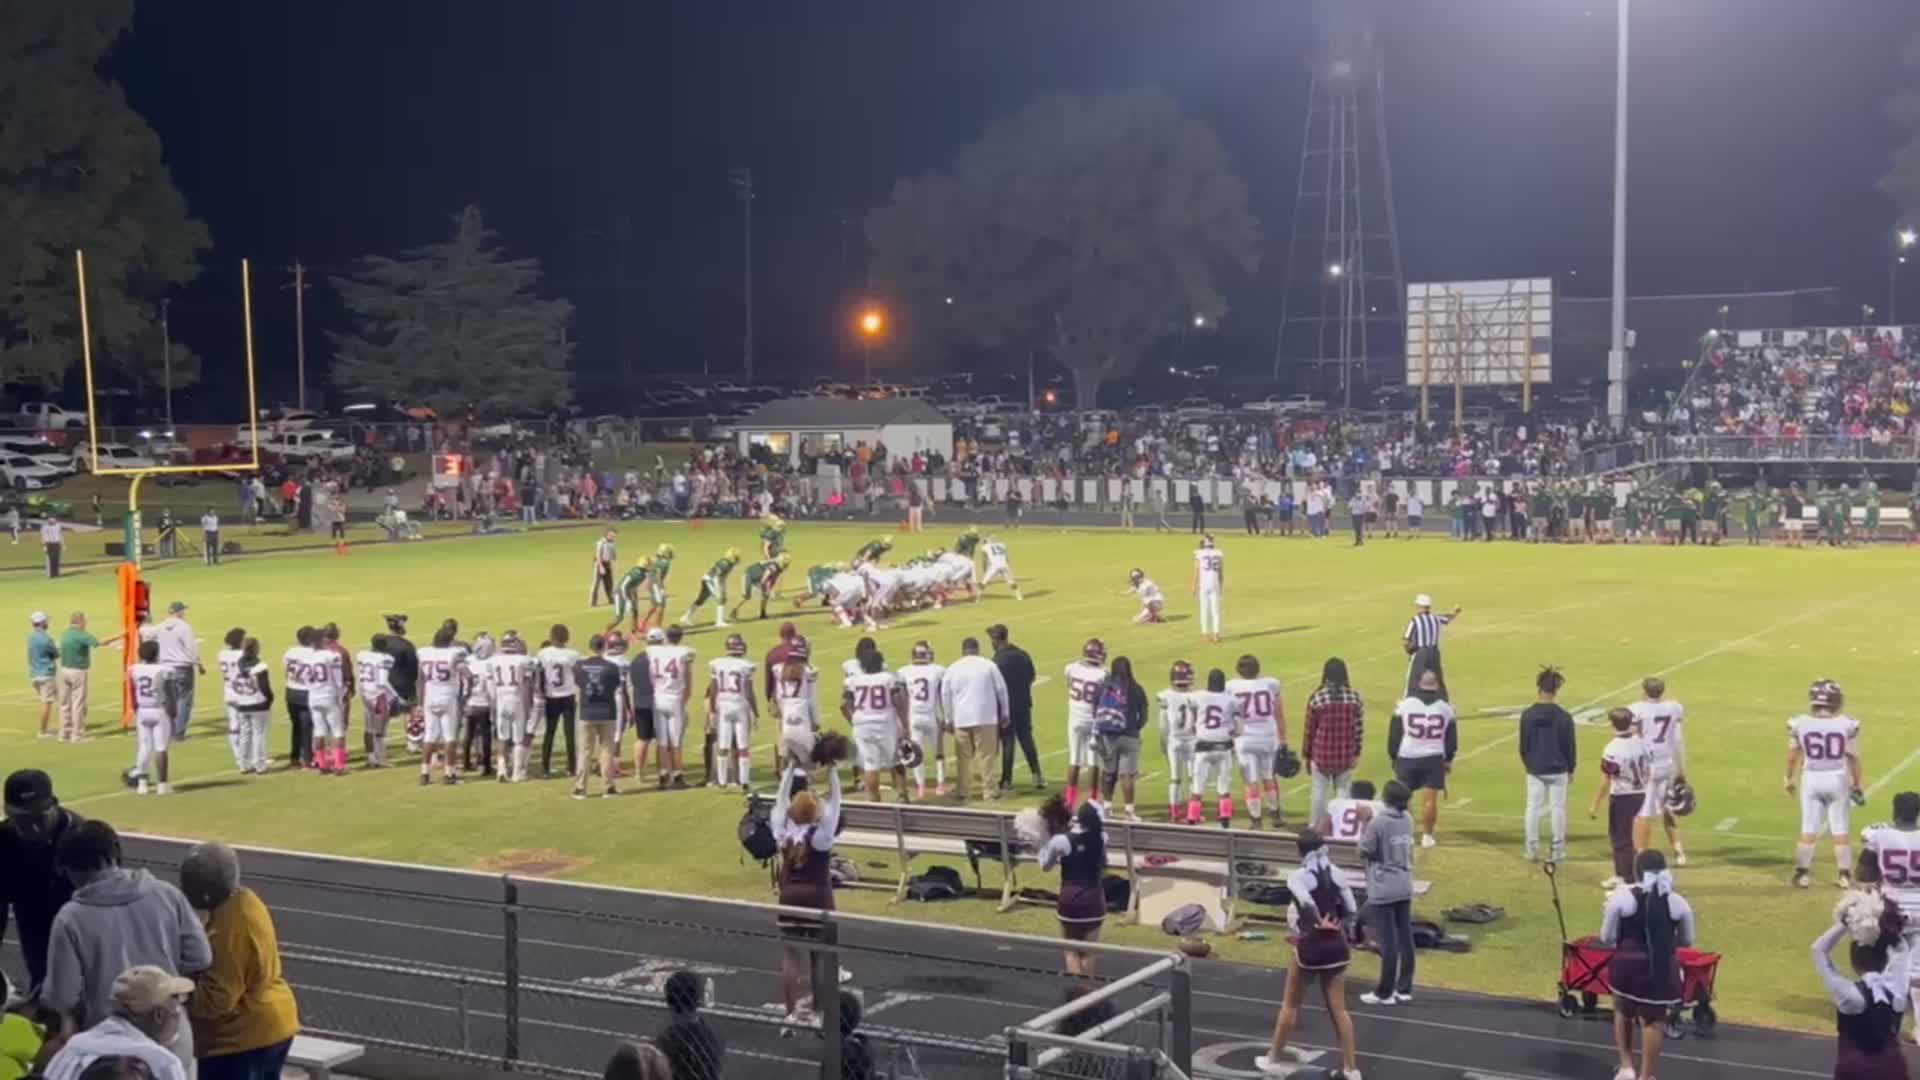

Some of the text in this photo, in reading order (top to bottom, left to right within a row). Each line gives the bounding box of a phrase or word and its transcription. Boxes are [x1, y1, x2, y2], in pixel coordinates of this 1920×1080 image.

[421, 661, 450, 681] 75
[496, 666, 519, 686] 11
[654, 657, 678, 679] 14
[139, 676, 153, 697] 2
[717, 671, 742, 693] 13
[914, 678, 929, 700] 3
[1071, 678, 1099, 703] 58
[854, 685, 889, 710] 78
[1235, 691, 1272, 718] 70
[1205, 706, 1223, 729] 6
[1408, 714, 1445, 739] 52
[1653, 716, 1672, 743] 7
[1803, 732, 1847, 760] 60
